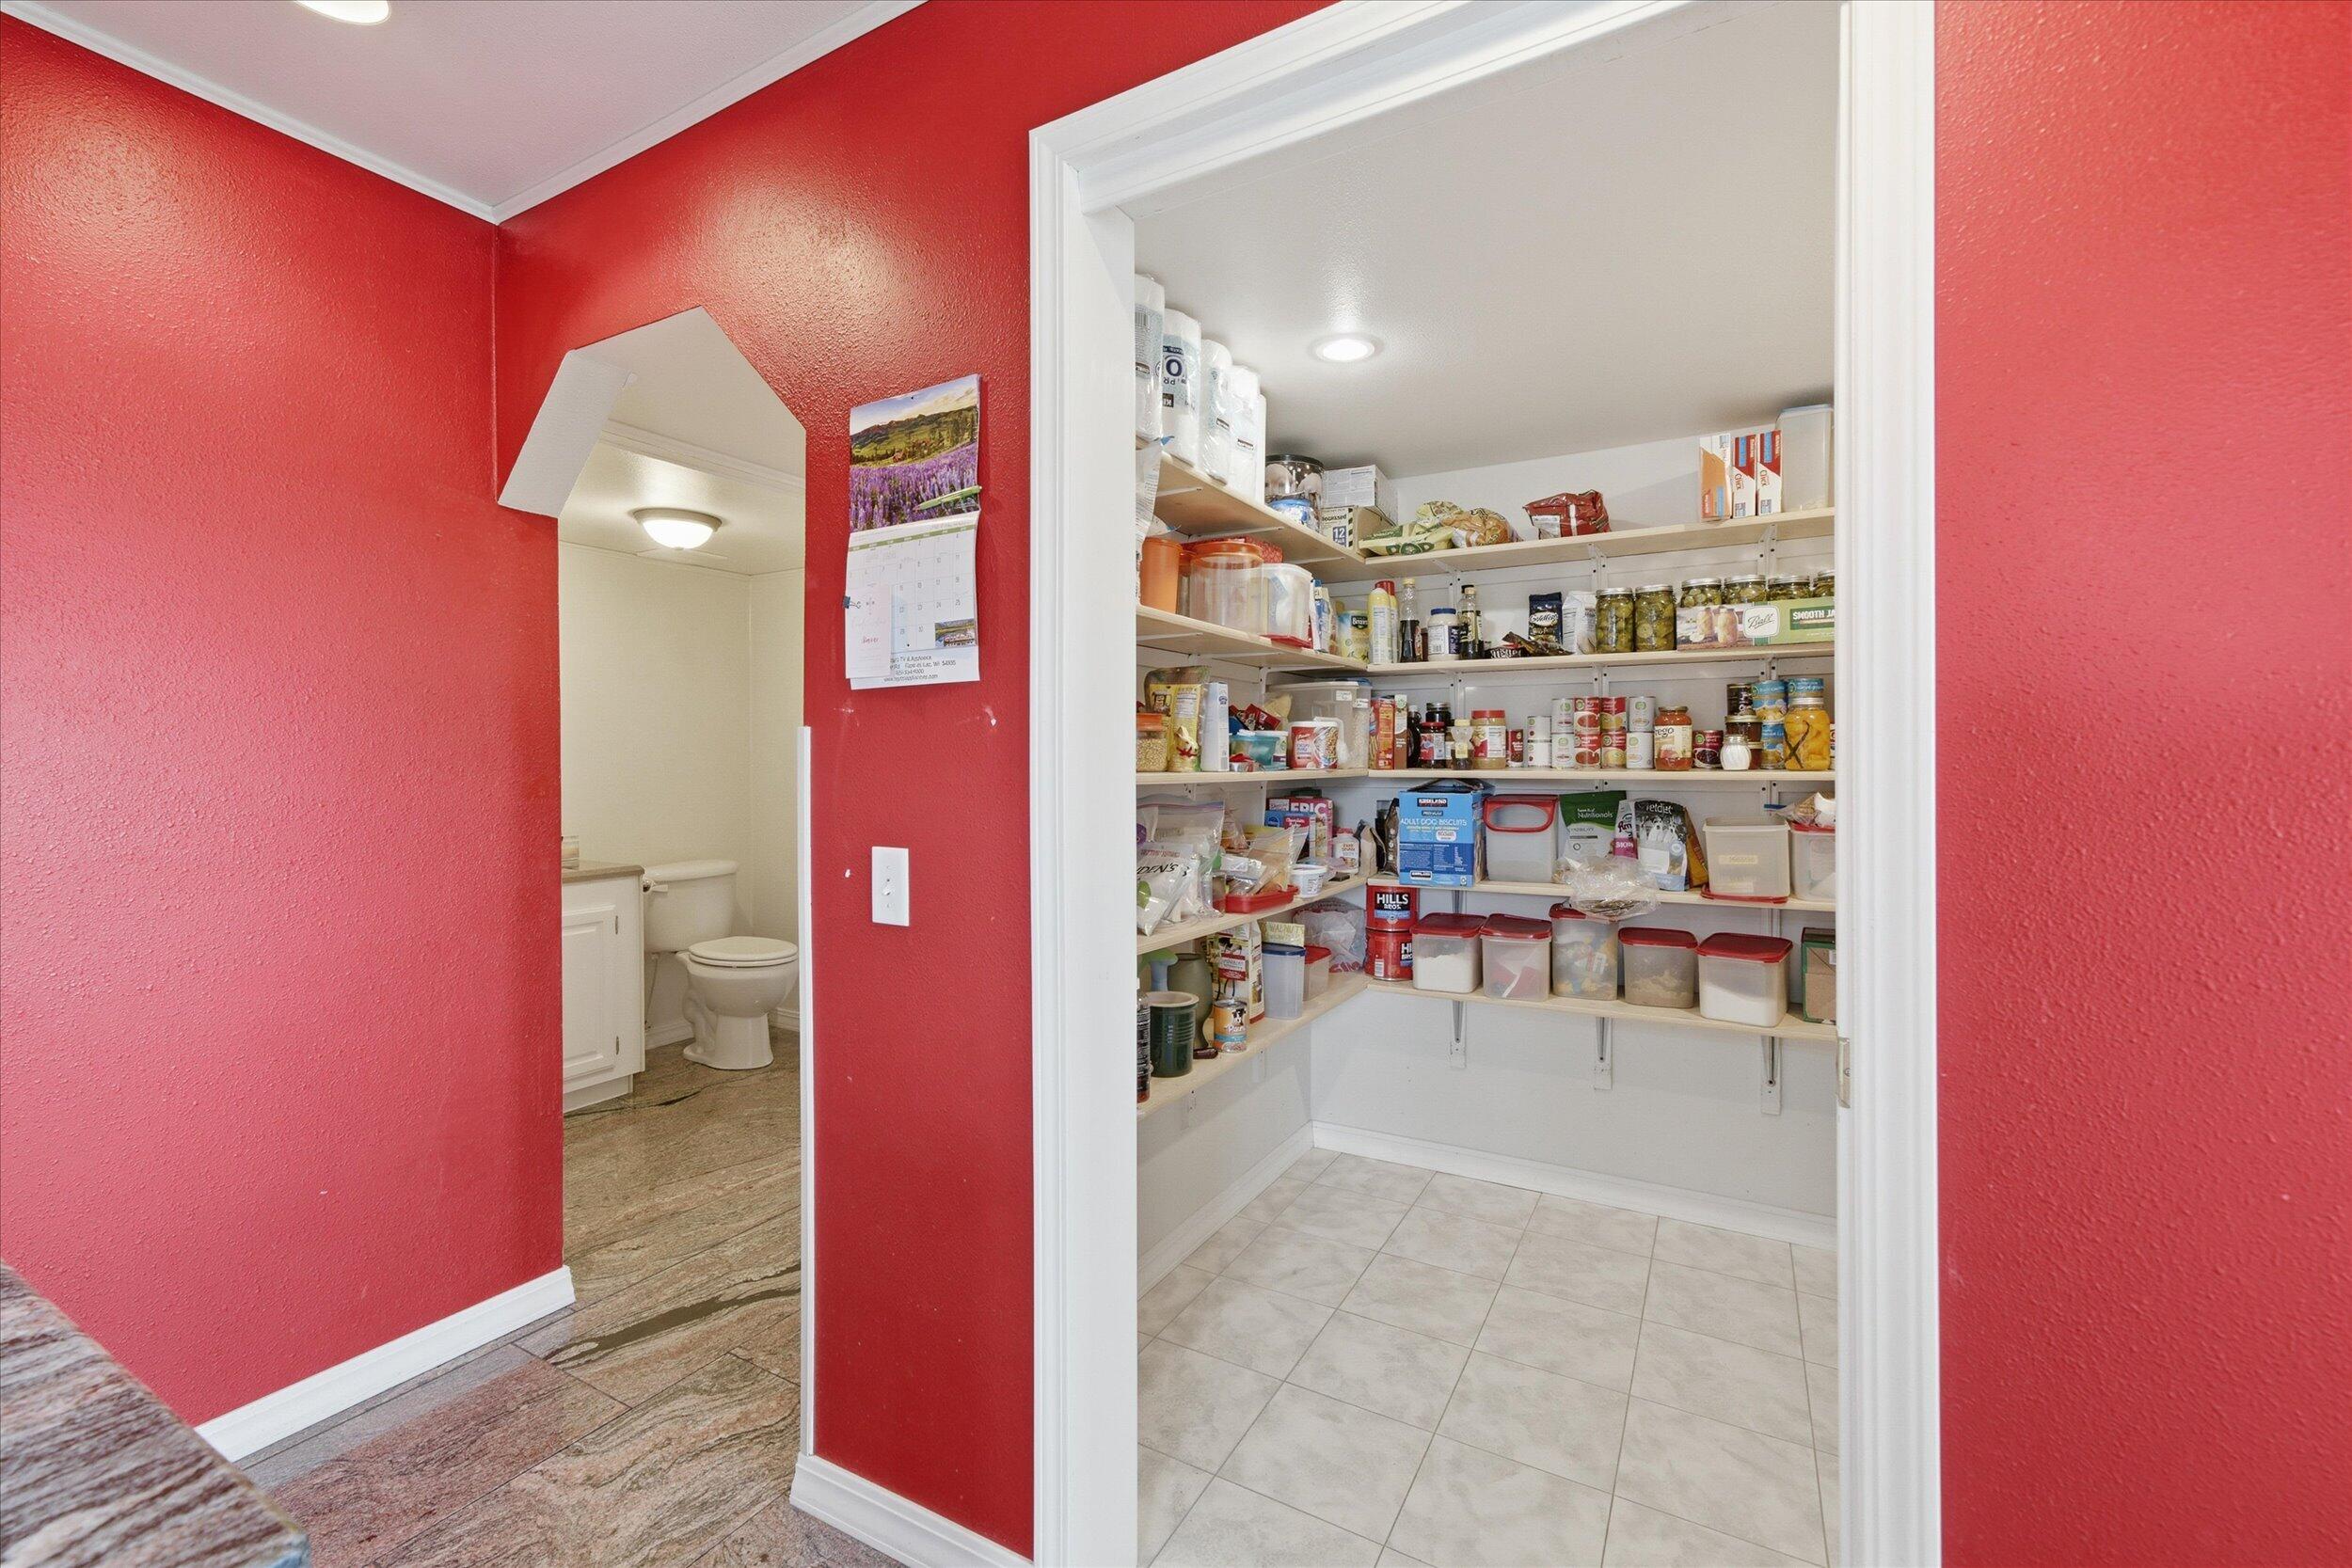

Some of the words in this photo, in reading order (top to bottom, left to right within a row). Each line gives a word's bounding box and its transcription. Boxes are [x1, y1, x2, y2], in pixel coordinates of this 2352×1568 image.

[1333, 527, 1345, 538] 12
[1792, 609, 1825, 620] SMOOTH
[1747, 613, 1775, 629] Ball
[1655, 726, 1674, 737] rego
[1376, 893, 1409, 904] HILLS
